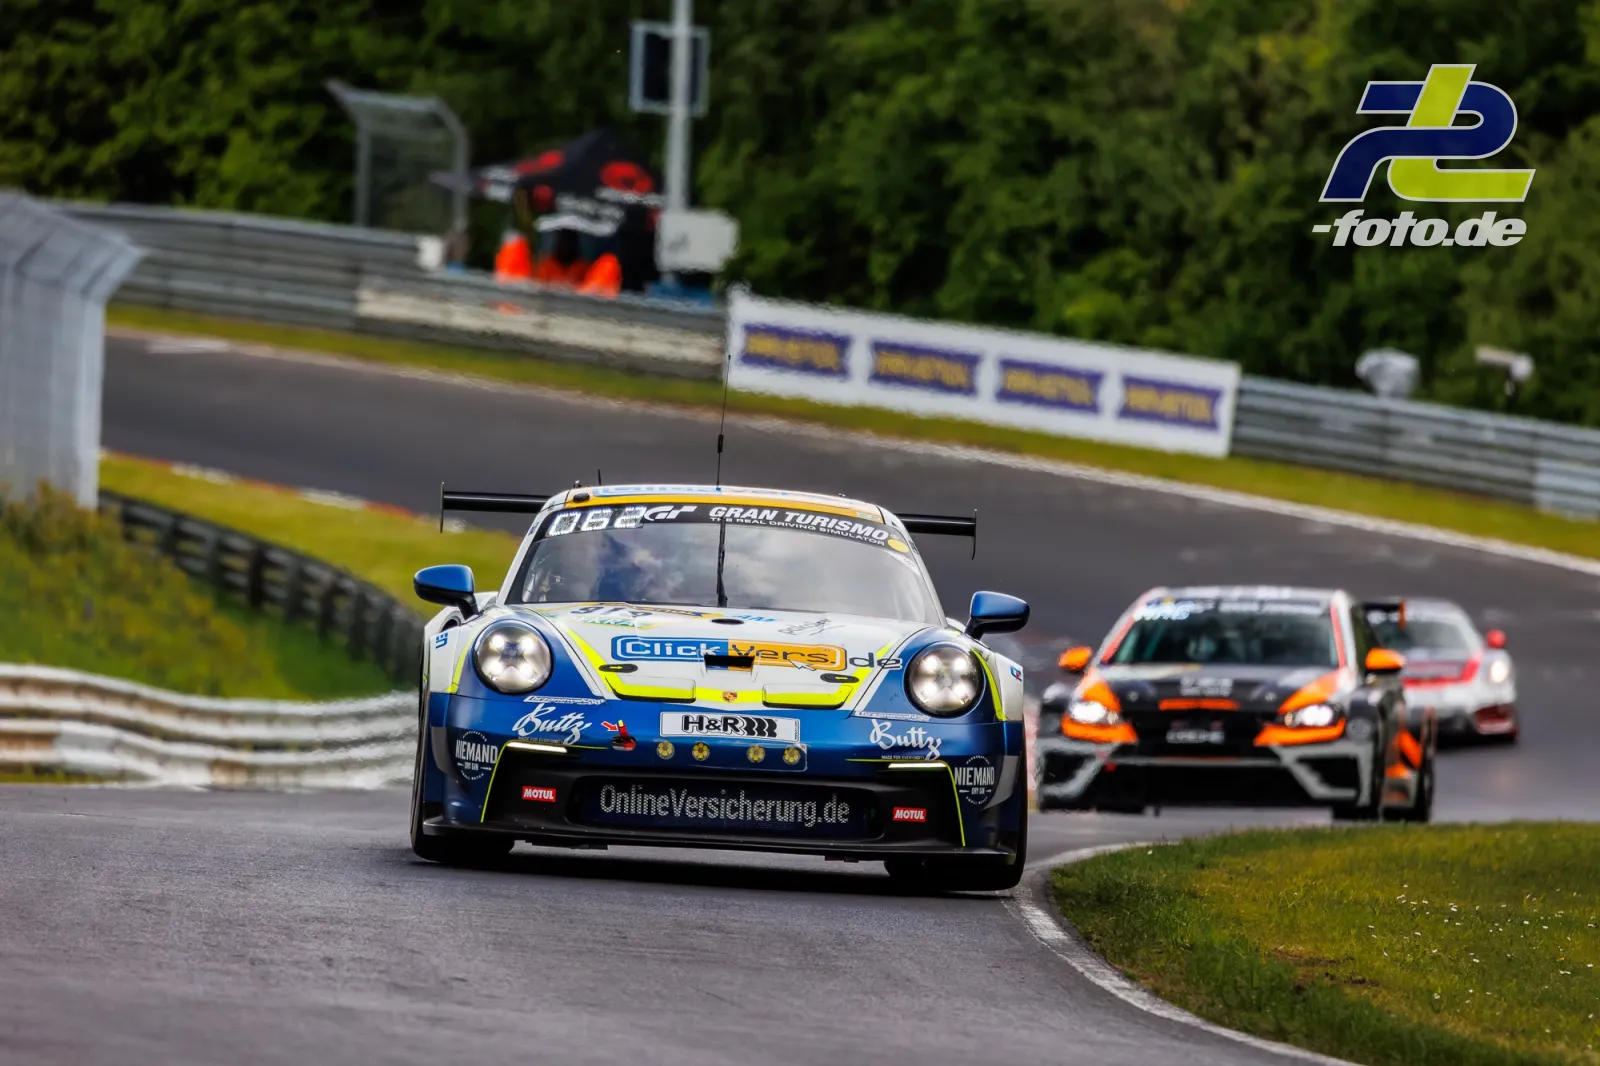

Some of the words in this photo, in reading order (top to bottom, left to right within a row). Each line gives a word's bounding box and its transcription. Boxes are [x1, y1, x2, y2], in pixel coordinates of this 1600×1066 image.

[708, 506, 779, 521] GRAN
[785, 511, 889, 541] TURISMO
[769, 521, 817, 531] DRIVING
[819, 527, 885, 546] SIMULATOR
[625, 641, 721, 657] Click
[954, 766, 995, 786] NIEMAND
[523, 788, 555, 800] MOTUL
[600, 783, 850, 828] OnlineVersicherung.de
[894, 809, 925, 820] MOTUL
